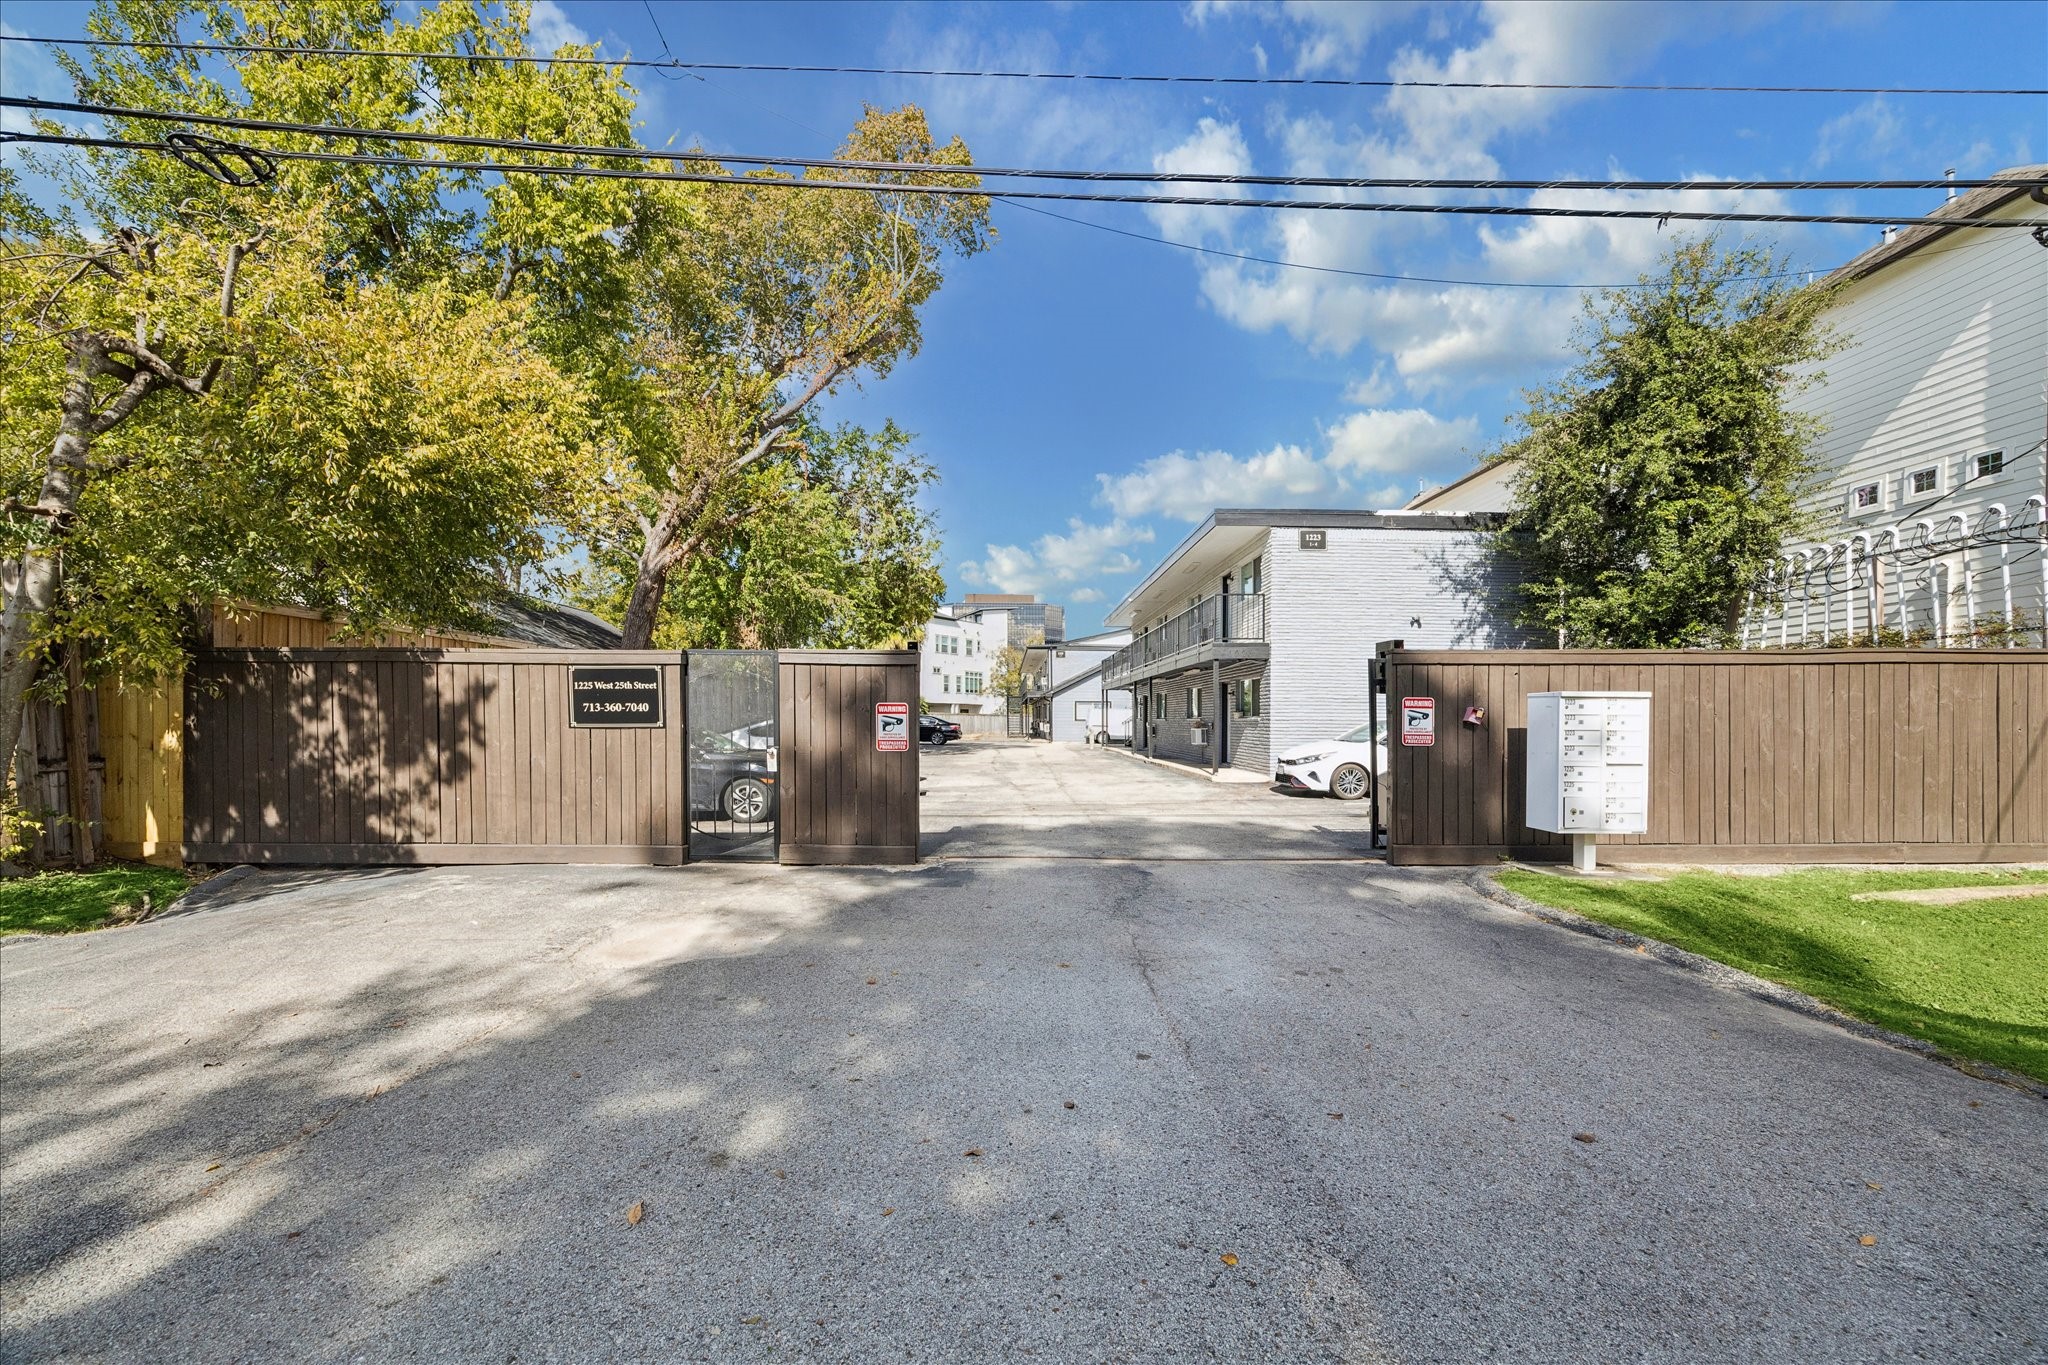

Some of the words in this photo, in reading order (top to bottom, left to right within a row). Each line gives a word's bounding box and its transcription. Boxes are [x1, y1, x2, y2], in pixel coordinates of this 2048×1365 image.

[574, 681, 593, 690] 1225
[594, 681, 614, 690] West
[614, 681, 633, 690] 25th
[633, 681, 657, 690] Street
[582, 702, 650, 712] 713-360-7040
[878, 705, 907, 713] WARNING
